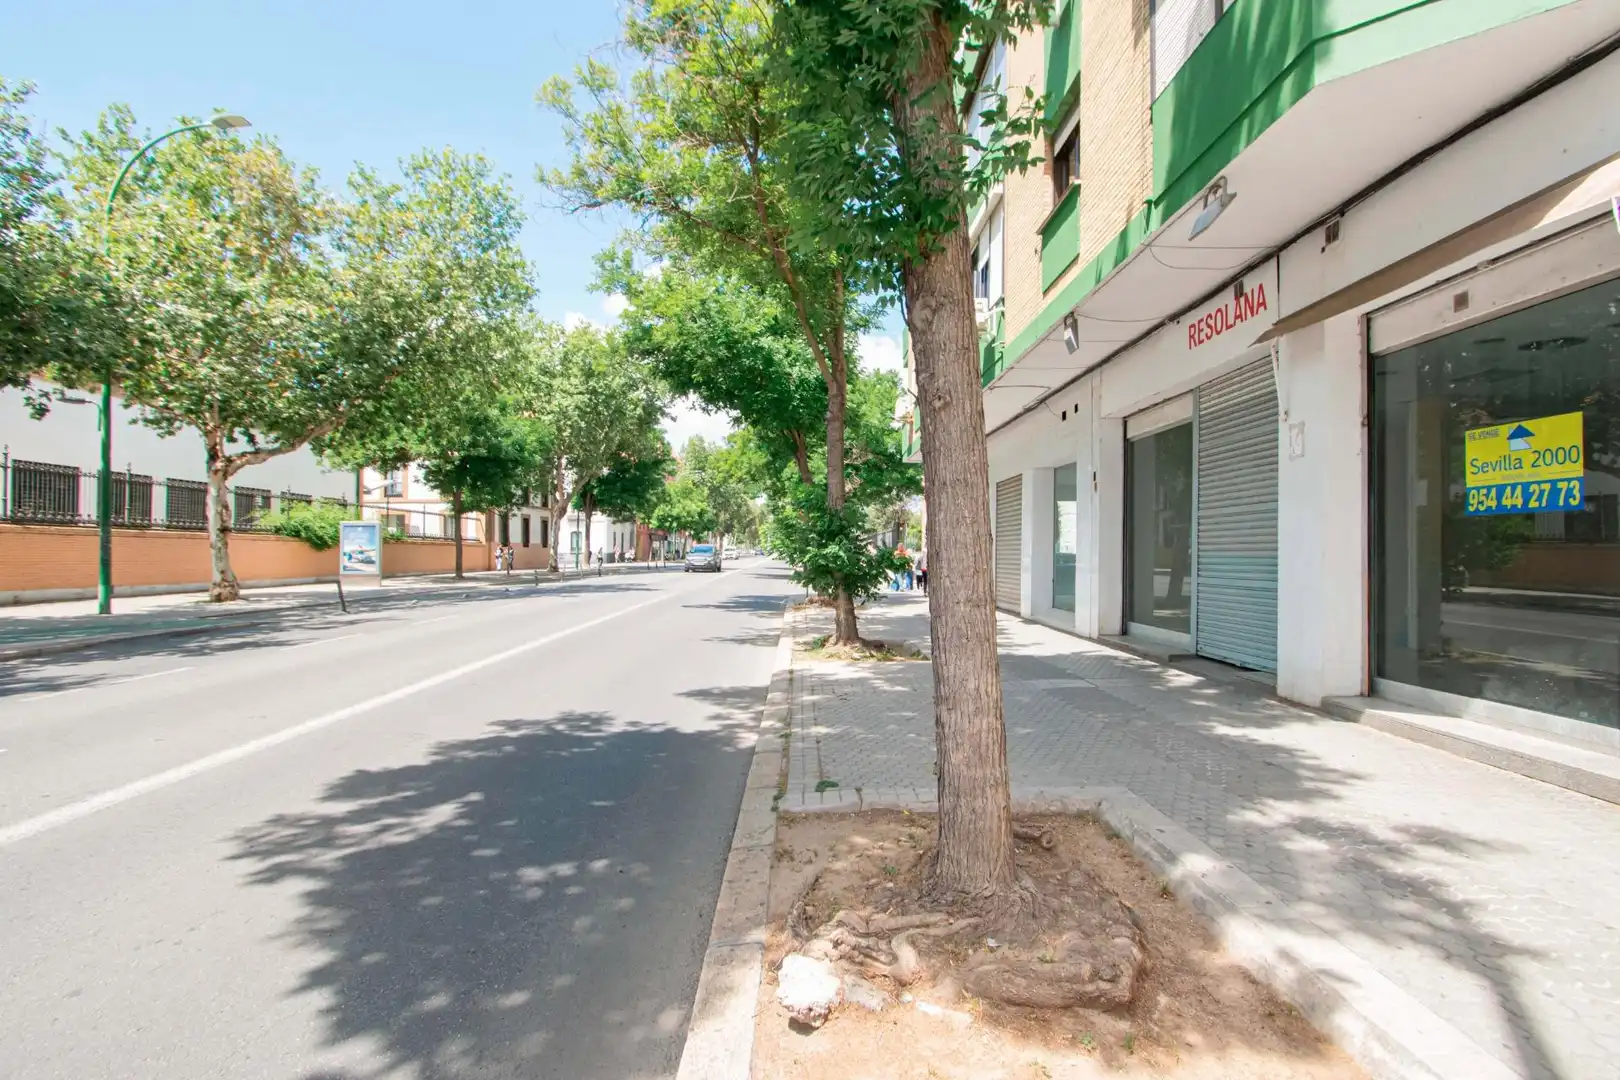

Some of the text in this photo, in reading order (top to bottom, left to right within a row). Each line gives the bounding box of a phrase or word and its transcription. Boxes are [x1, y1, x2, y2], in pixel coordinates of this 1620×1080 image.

[1188, 283, 1267, 350] RESOLANA
[1478, 428, 1500, 439] VENDE
[1469, 445, 1581, 475] Sevilla 2000
[1467, 479, 1581, 512] 954 44 27 73
